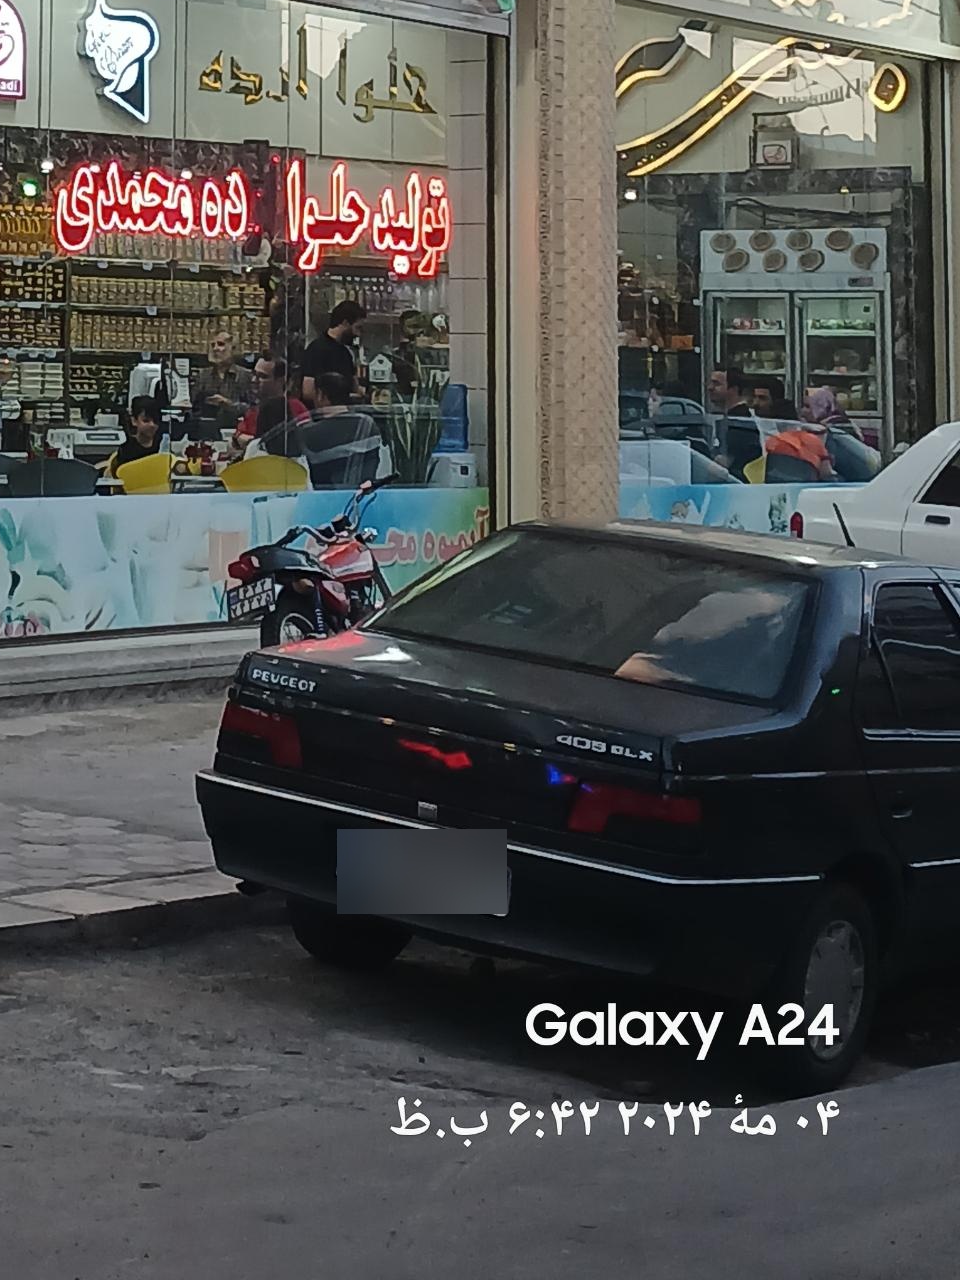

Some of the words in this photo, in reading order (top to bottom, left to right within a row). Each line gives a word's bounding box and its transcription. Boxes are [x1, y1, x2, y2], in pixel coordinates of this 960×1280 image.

[336, 28, 439, 124] حلوا
[286, 159, 372, 271] حلوا
[372, 172, 451, 277] تولید
[252, 668, 317, 694] PEUGEOT
[555, 734, 608, 754] 405
[609, 743, 654, 763] GLX
